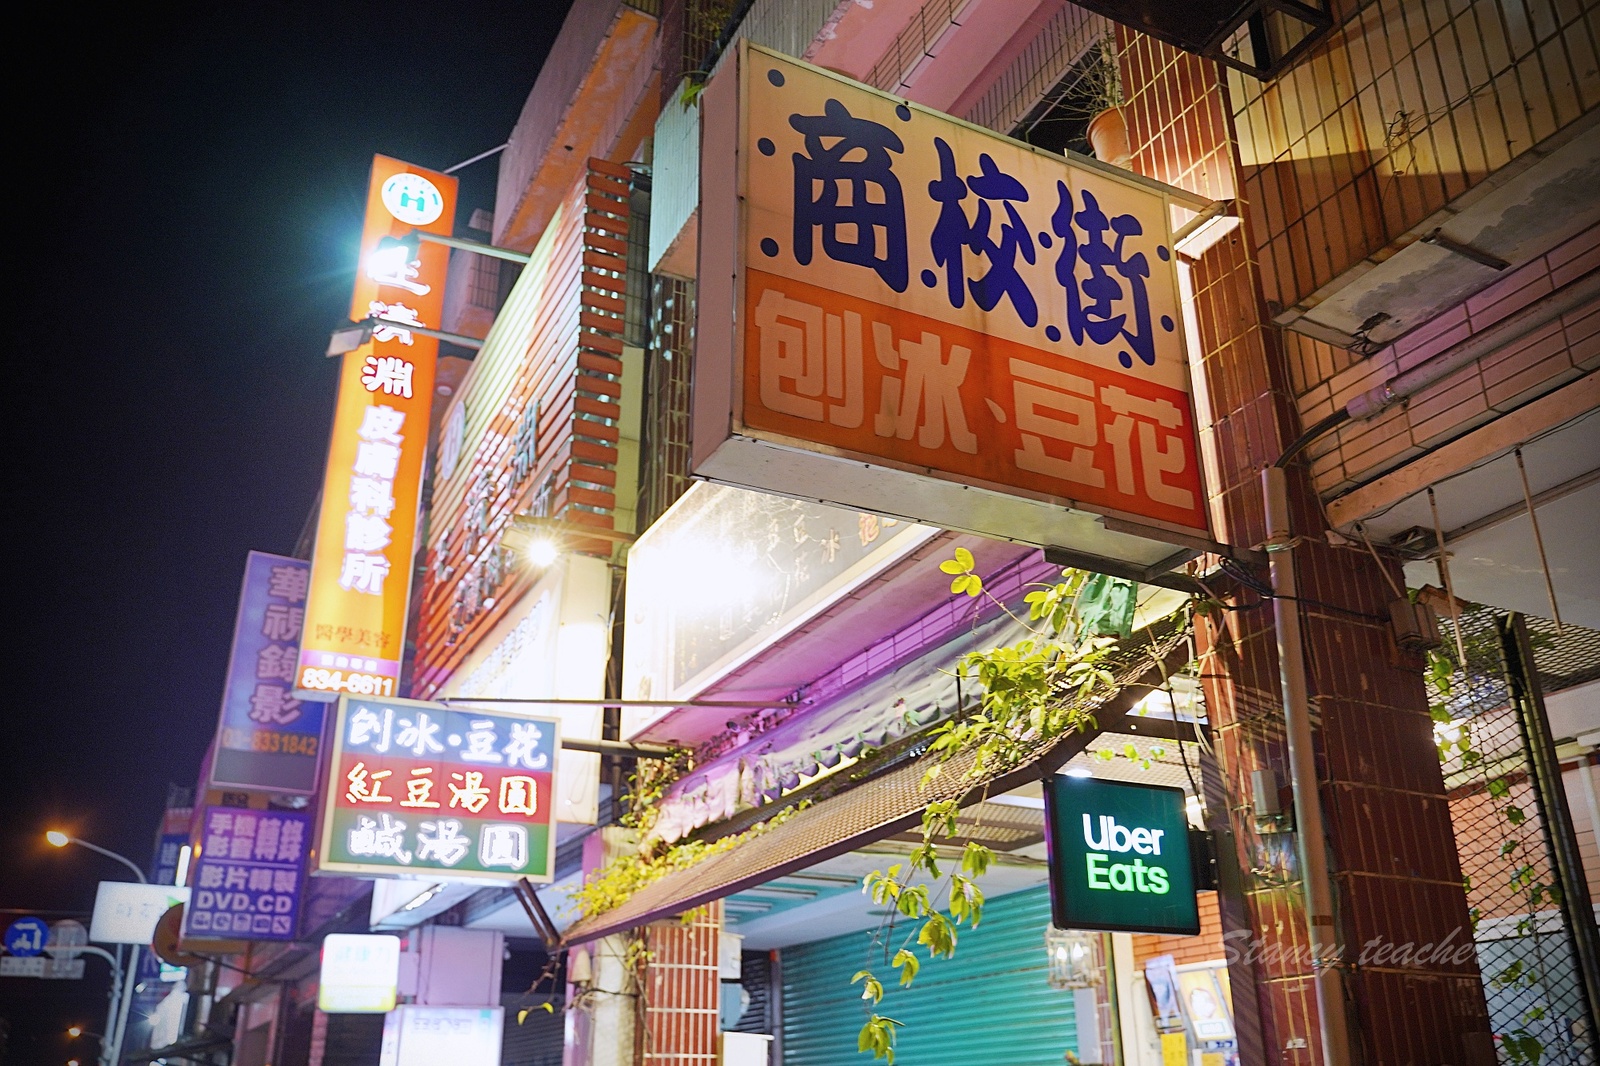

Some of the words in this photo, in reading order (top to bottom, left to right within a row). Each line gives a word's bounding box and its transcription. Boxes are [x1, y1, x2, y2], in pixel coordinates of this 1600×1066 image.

[788, 98, 1156, 366] 商校街
[315, 623, 391, 649] 醫學美容
[302, 667, 394, 697] 834-6611
[345, 762, 537, 816] 紅豆湯圓
[349, 813, 528, 869] 鹹湯圓
[1082, 813, 1164, 856] Uber
[1086, 852, 1170, 895] Eats
